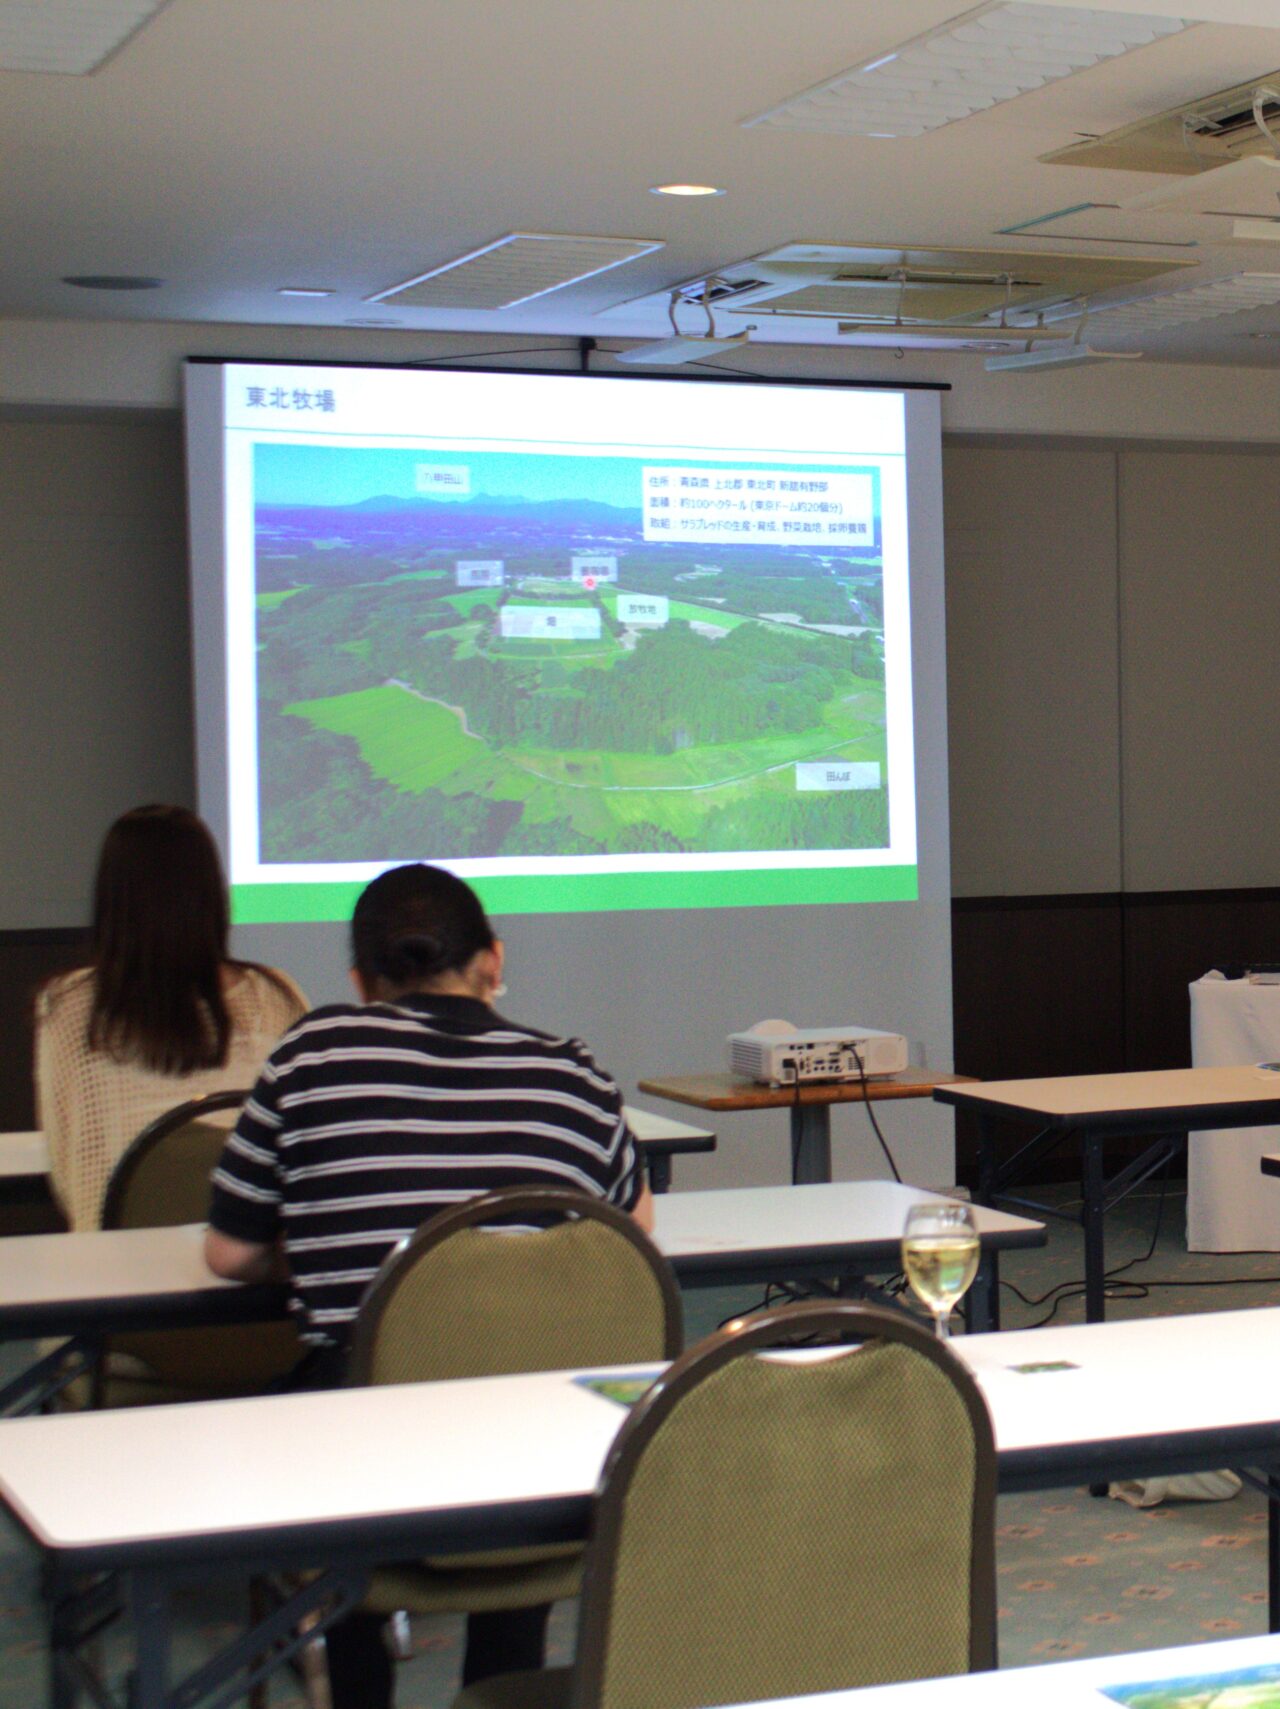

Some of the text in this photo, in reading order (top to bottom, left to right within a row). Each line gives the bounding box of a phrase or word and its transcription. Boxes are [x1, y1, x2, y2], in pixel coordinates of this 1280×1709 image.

[245, 386, 336, 413] 東北牧場
[714, 477, 744, 490] 上北郡
[747, 479, 776, 491] 東北町
